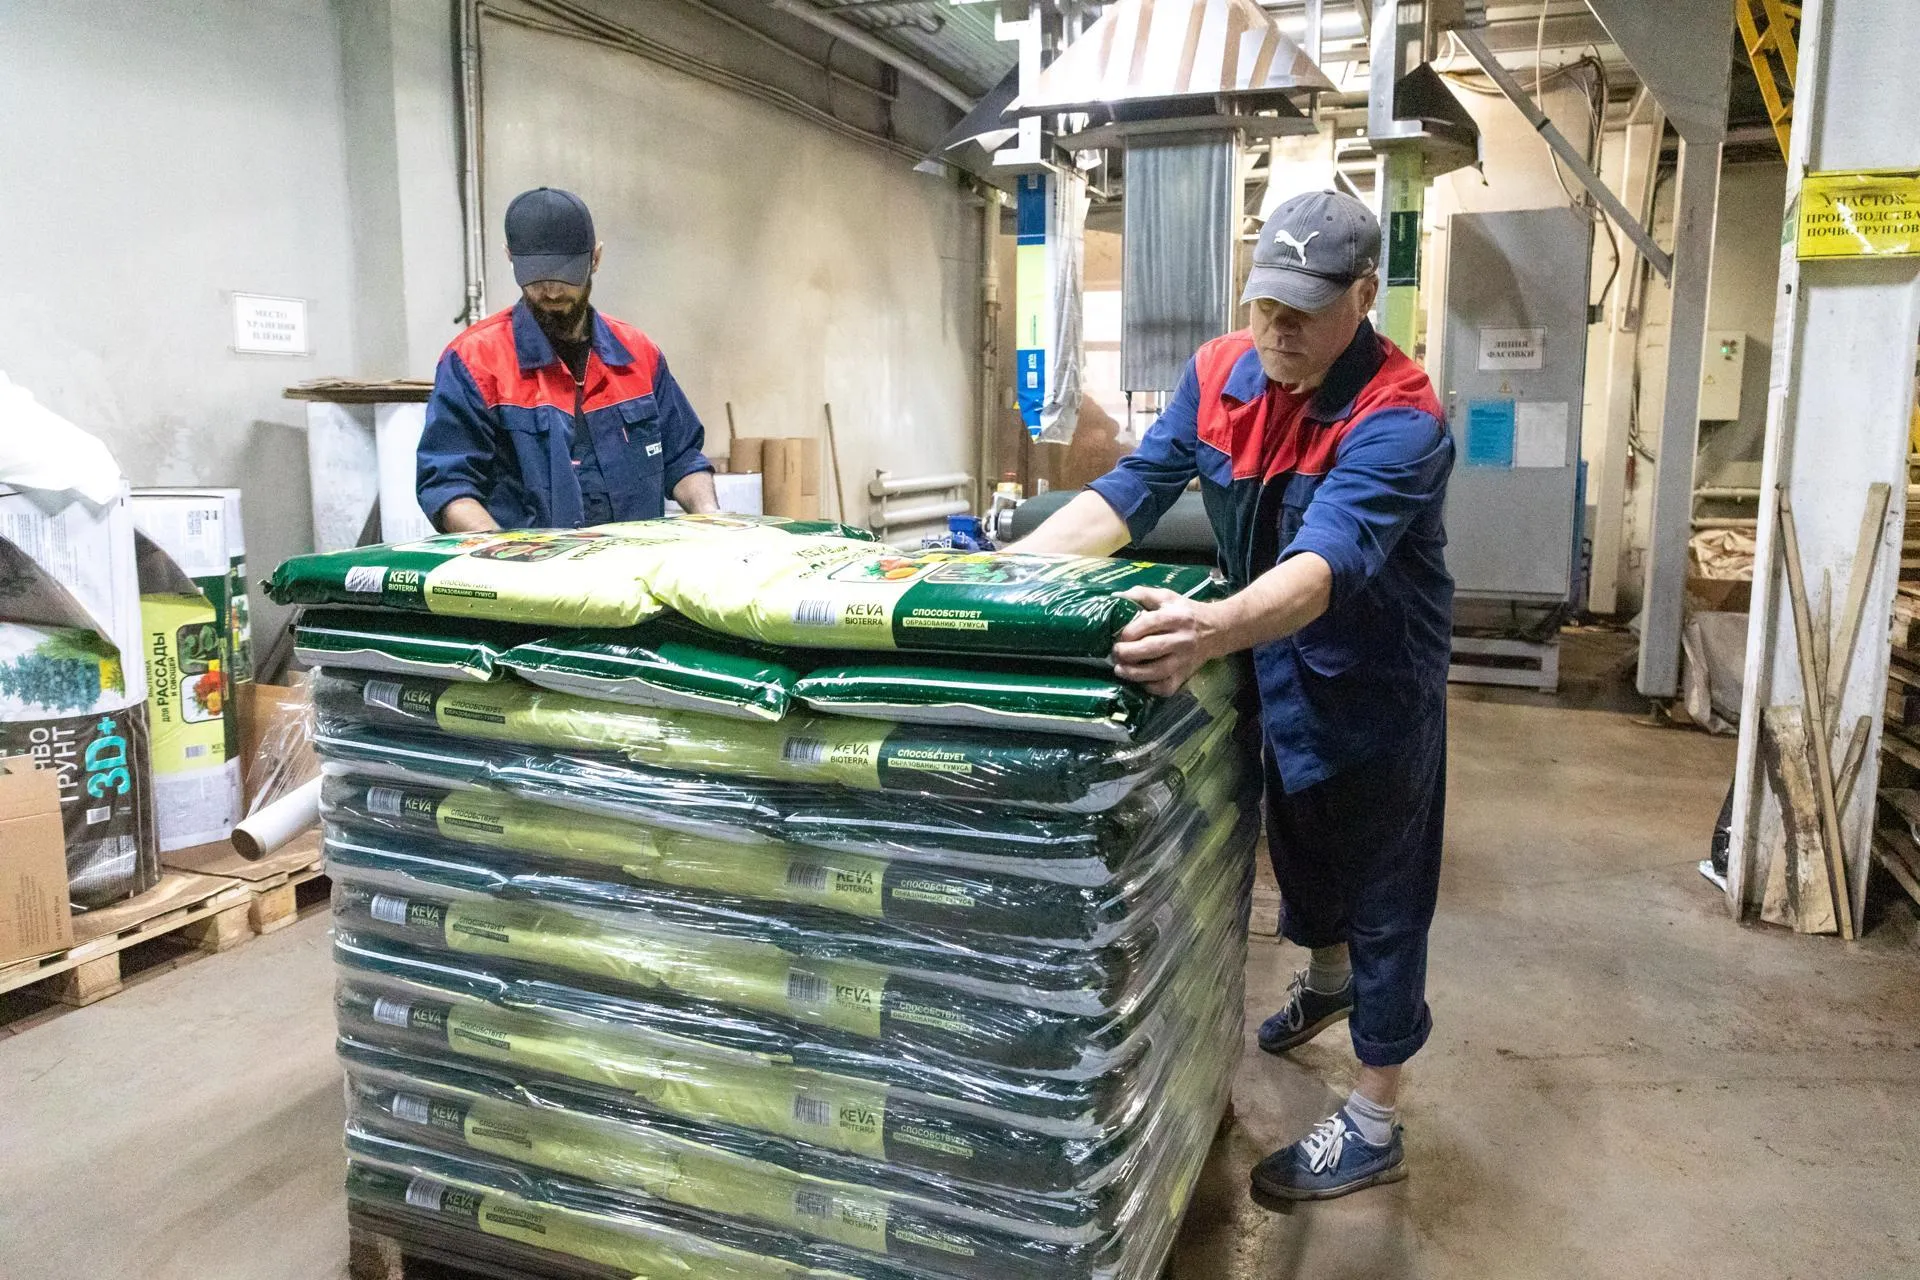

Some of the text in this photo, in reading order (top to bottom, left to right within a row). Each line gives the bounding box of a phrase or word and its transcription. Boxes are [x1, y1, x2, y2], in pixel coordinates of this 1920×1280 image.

[1820, 192, 1907, 208] УЧАСТОК
[1487, 350, 1535, 358] ФАСОВКИ
[389, 570, 419, 585] KEVA
[388, 584, 418, 593] BIOTERRA
[434, 588, 495, 599] ОБРАЗОВАНИЮ ГУМУСА
[846, 603, 884, 617] KEVA
[912, 608, 982, 619] СПОСОБСТВУЕТ
[845, 617, 884, 626] BIOTERRA
[905, 619, 986, 630] ОБРАЗОВАНИЮ ГУМУСА
[153, 632, 169, 707] РАССАДЫ
[403, 689, 431, 704] KEVA
[451, 701, 502, 713] СПОСОБСТВУЕТ
[833, 743, 870, 756] KEVA
[897, 749, 966, 761] СПОСОБСТВУЕТ
[830, 756, 869, 766] BIOTERRA
[405, 798, 432, 813] KEVA
[836, 870, 874, 886] KEVA
[836, 883, 873, 895] BIOTERRA
[411, 904, 440, 920] KEVA
[836, 985, 872, 1004] KEVA
[413, 1008, 441, 1024] KEVA
[433, 1106, 460, 1123] KEVA
[840, 1106, 876, 1126] KEVA
[447, 1191, 474, 1209] KEVA
